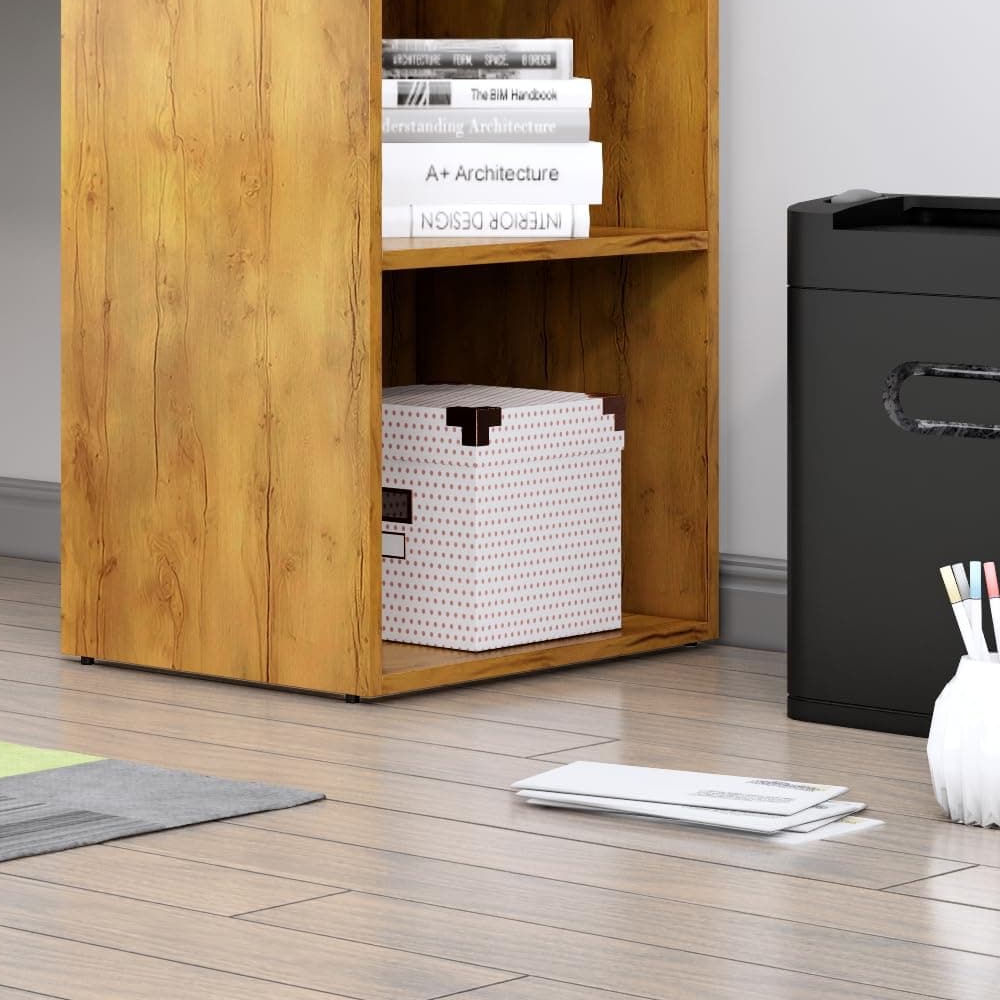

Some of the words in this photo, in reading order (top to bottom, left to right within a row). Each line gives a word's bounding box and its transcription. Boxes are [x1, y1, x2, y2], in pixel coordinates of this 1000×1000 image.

[471, 88, 488, 101] The
[490, 88, 508, 101] BIM
[511, 88, 557, 101] Handbook
[469, 118, 557, 134] Architecture
[425, 164, 450, 182] A+
[455, 164, 559, 182] Architecture
[421, 211, 484, 231] DESIGN
[489, 211, 562, 231] INTERIOR
